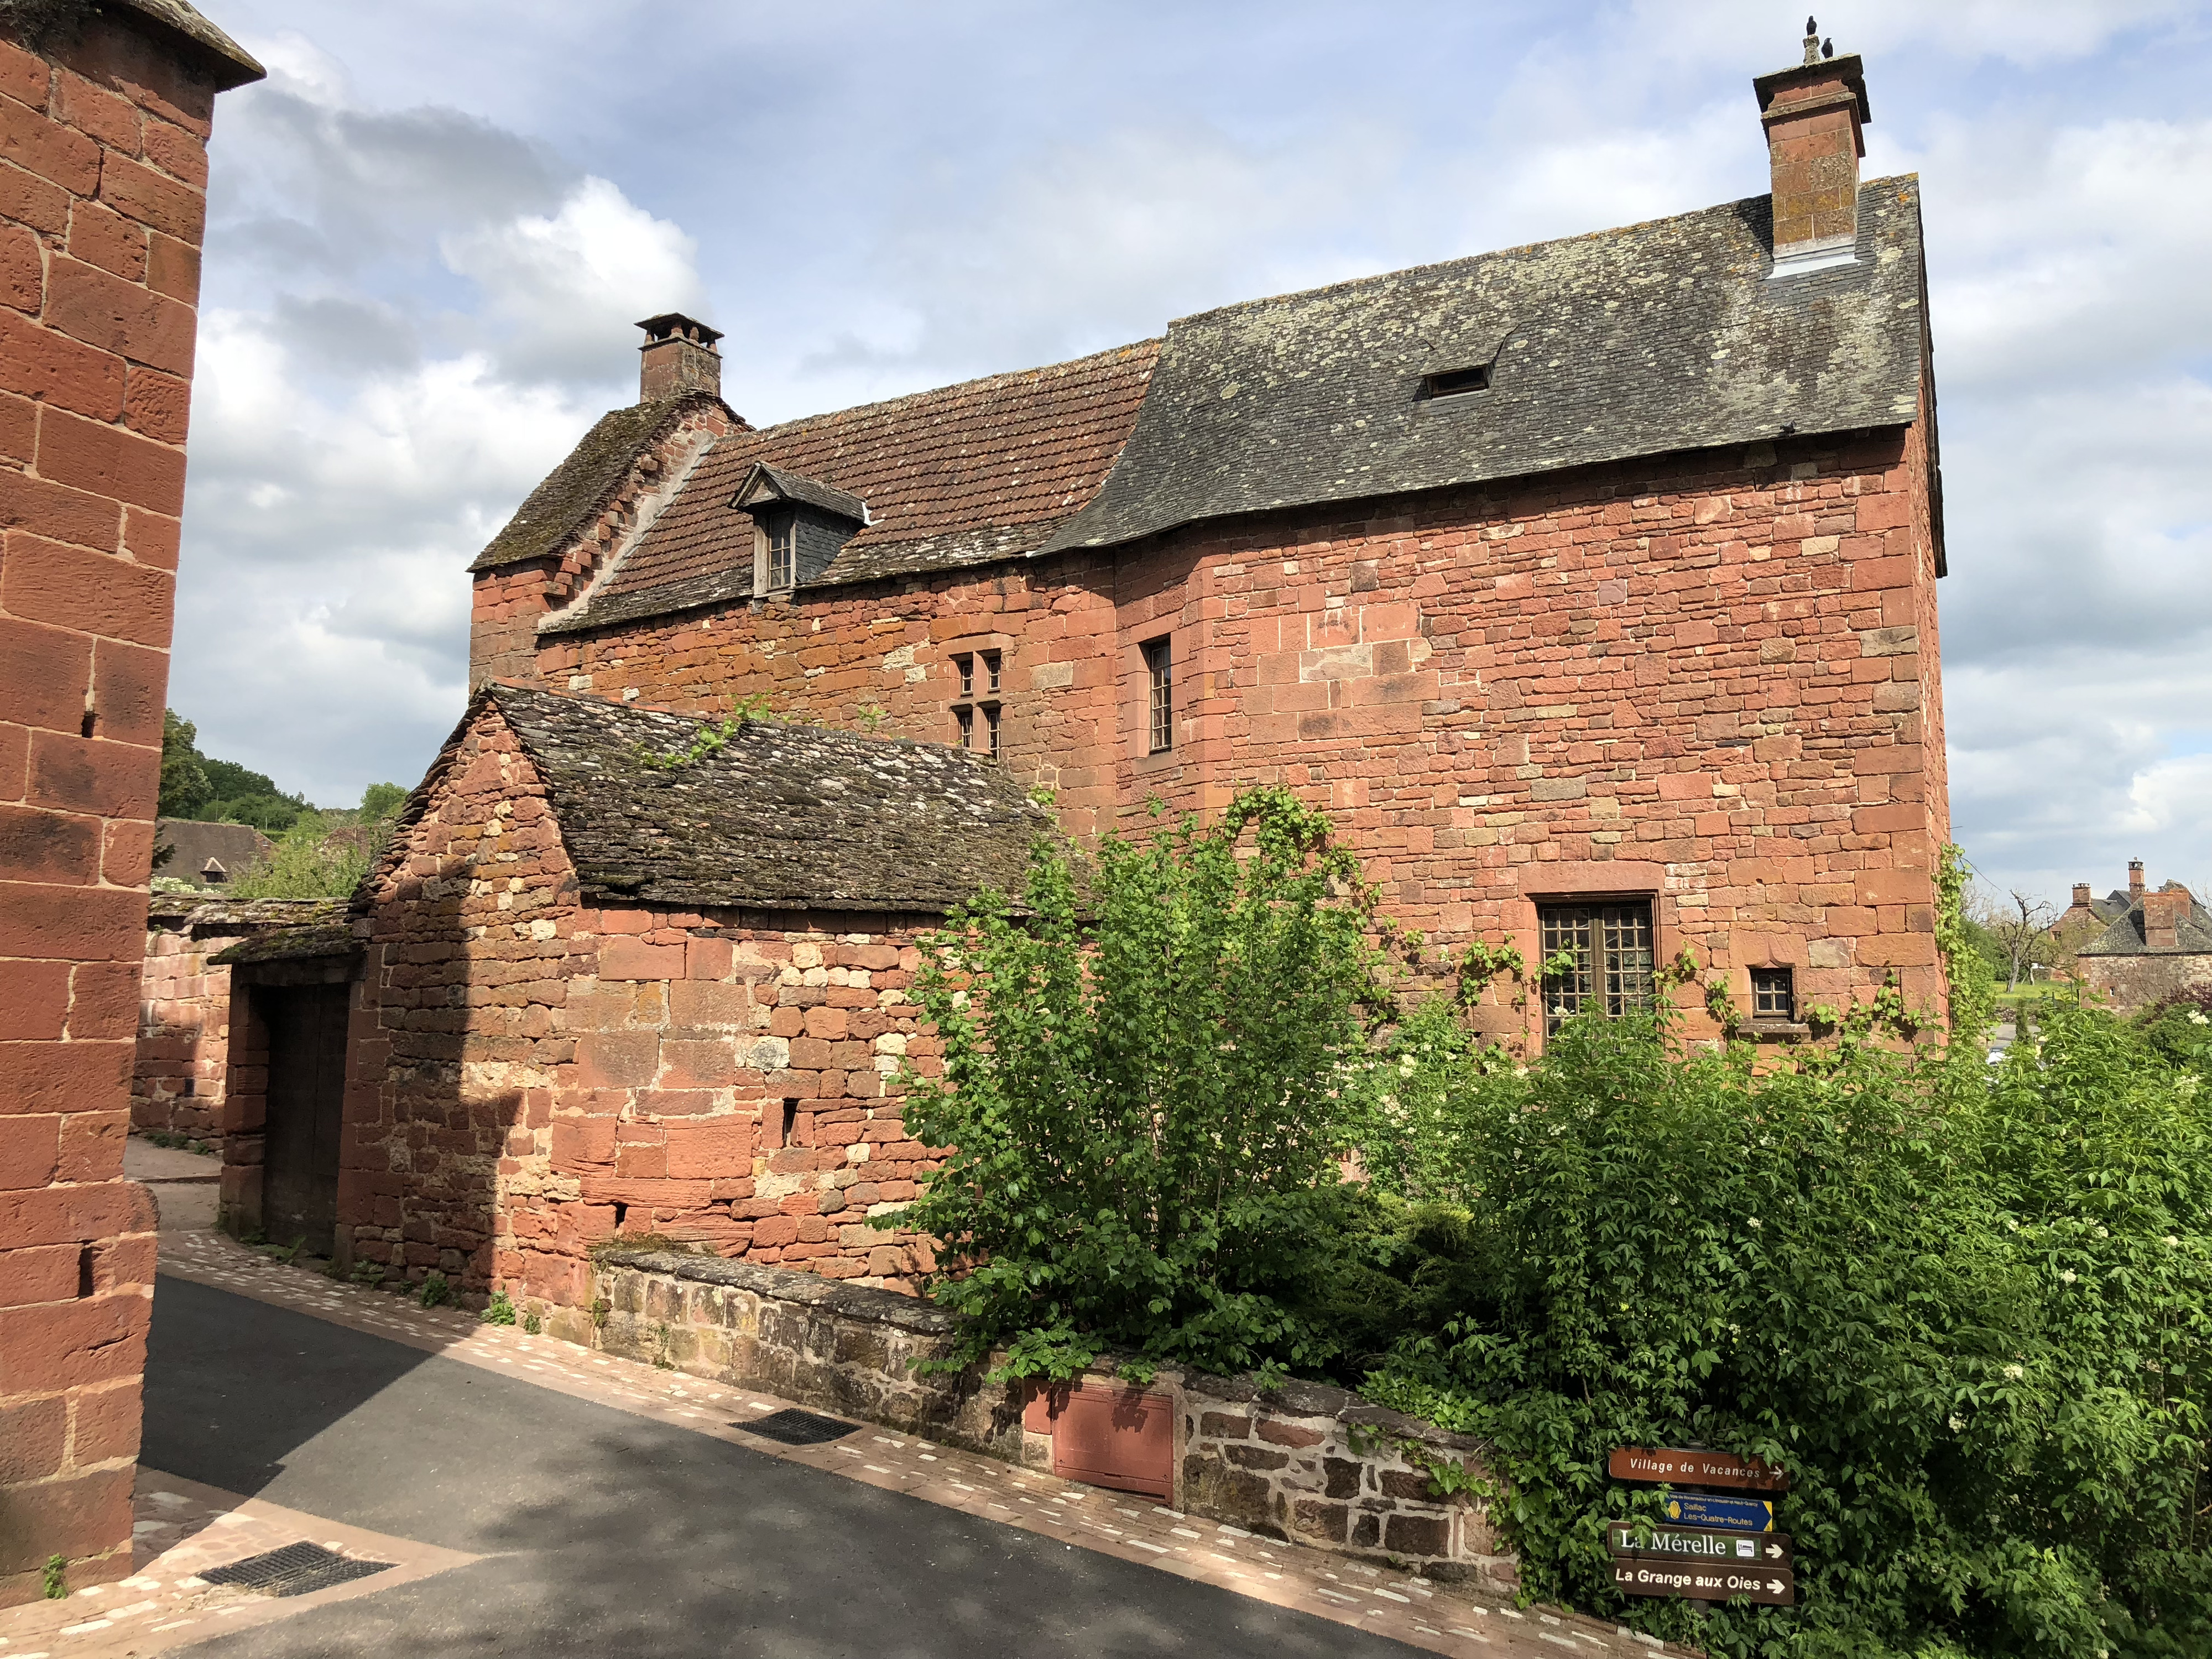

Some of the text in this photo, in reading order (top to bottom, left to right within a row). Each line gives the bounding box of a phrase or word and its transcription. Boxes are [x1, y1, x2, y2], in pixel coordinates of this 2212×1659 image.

[1630, 1458, 1760, 1478] Village de Vacances
[1684, 1503, 1707, 1512] Saillac
[1684, 1512, 1753, 1526] Les-Quatre-Routes
[1650, 1532, 1726, 1555] Mérelle
[1615, 1568, 1761, 1590] La Grange aux Oies
